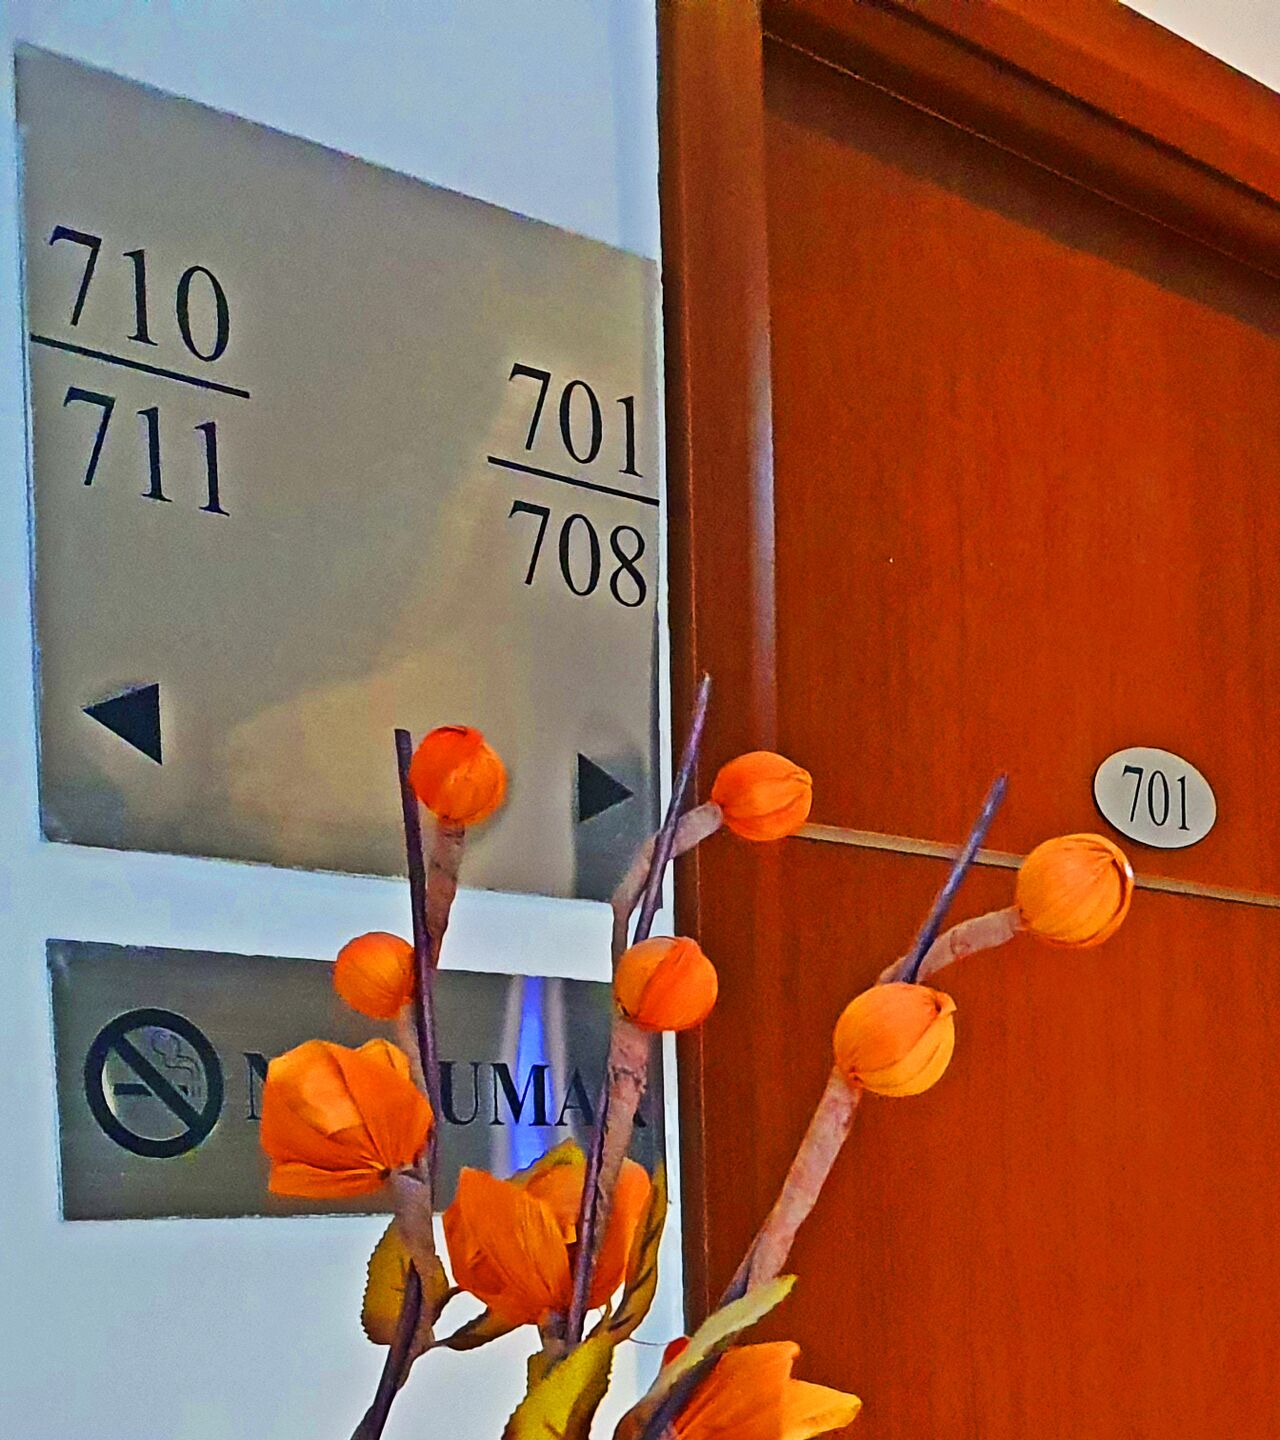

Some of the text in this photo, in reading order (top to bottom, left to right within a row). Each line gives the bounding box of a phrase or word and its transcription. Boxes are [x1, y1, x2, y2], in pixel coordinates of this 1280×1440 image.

[48, 225, 231, 363] 710
[63, 386, 231, 517] 711
[508, 362, 644, 478] 701
[508, 499, 648, 608] 708
[1121, 764, 1191, 832] 701
